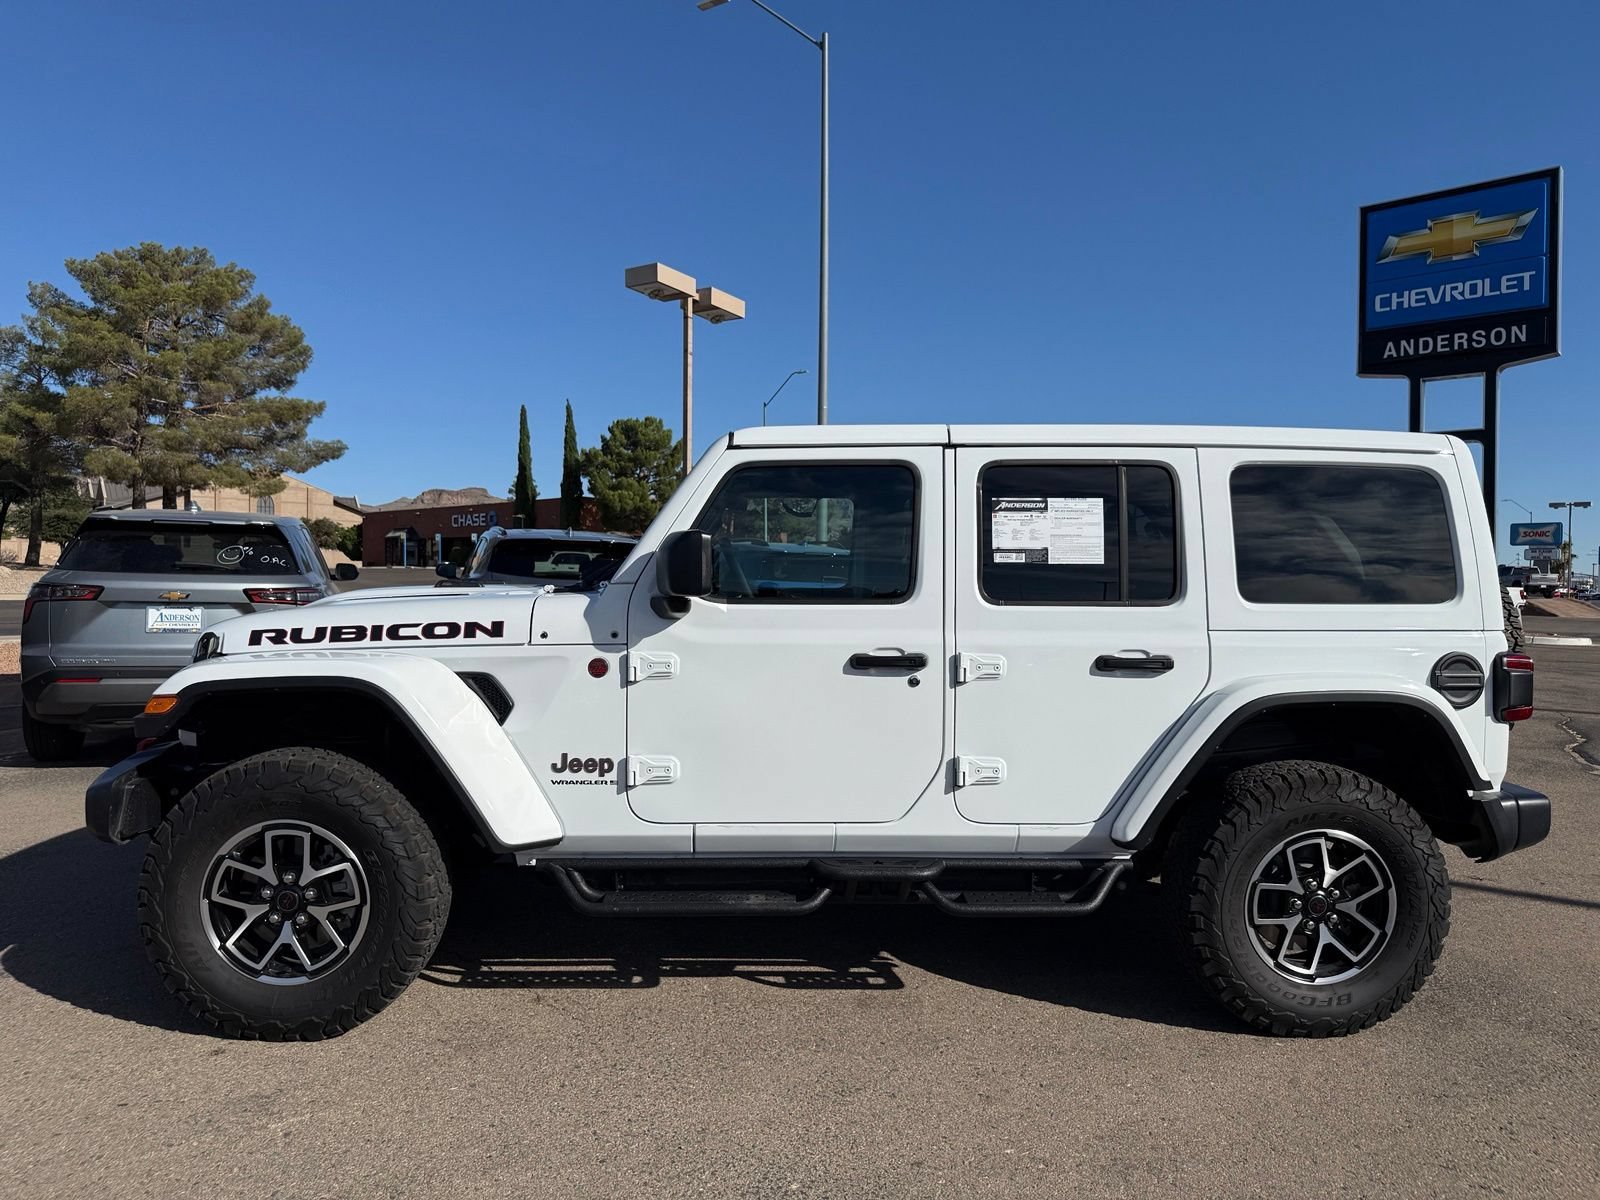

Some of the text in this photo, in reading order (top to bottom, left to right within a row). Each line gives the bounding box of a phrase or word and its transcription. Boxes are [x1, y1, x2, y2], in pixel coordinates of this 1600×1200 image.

[1374, 270, 1536, 313] CHEVROLET
[1383, 324, 1527, 359] ANDERSON
[994, 501, 1045, 510] ANDERSON
[451, 513, 486, 528] CHASE
[1521, 530, 1550, 538] SONIC
[151, 612, 200, 627] ANDERSON
[248, 621, 504, 646] RUBICON
[551, 753, 614, 777] Jeep
